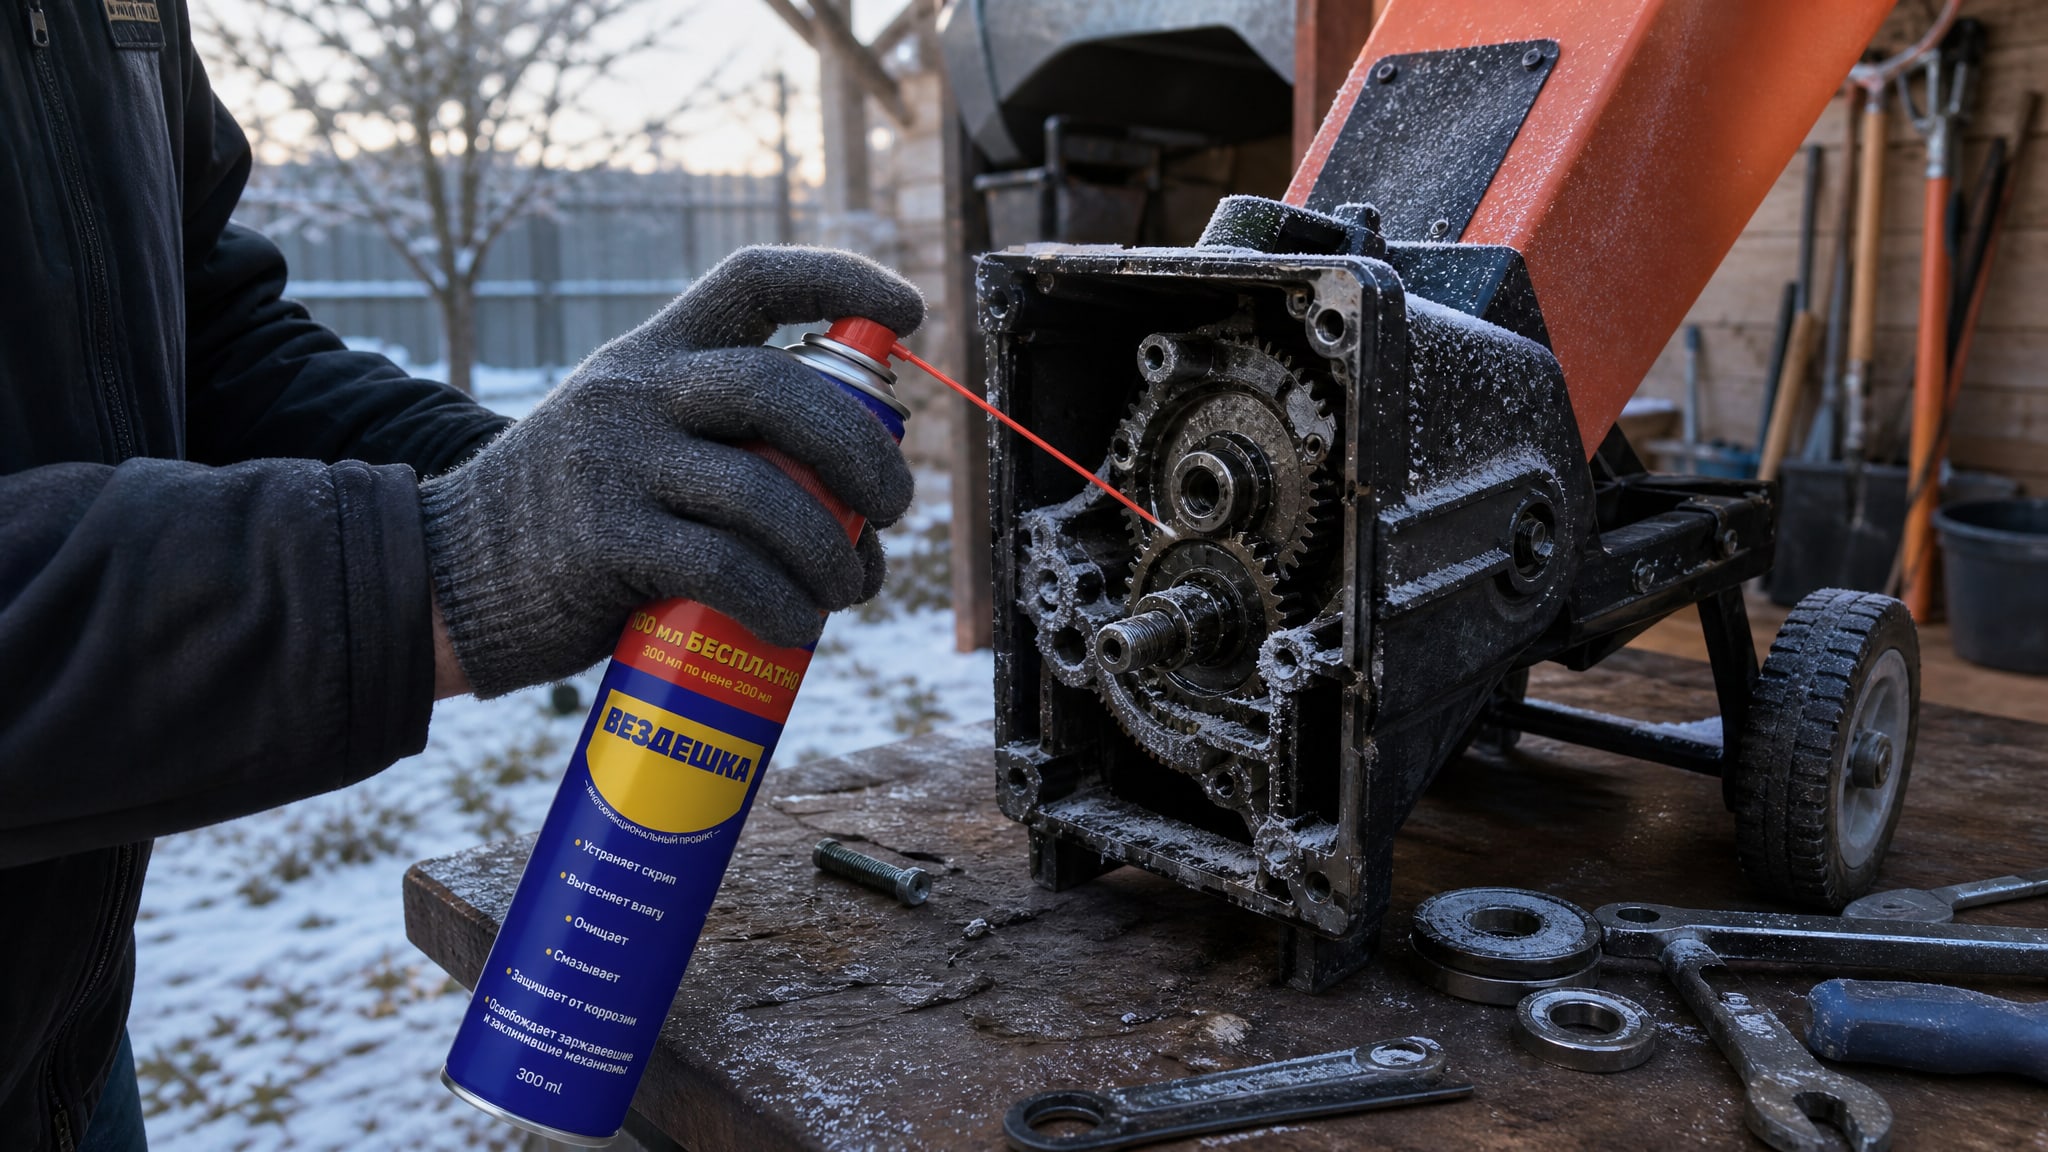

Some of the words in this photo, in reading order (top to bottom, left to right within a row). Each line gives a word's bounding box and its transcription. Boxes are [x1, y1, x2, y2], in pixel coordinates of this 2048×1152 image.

[632, 611, 657, 634] 100
[656, 624, 684, 646] мл
[685, 630, 800, 691] БЕСПЛАТНО
[642, 644, 665, 663] 300
[665, 655, 682, 670] мл
[683, 663, 701, 677] по
[701, 669, 733, 689] цене
[733, 680, 759, 698] 200
[758, 691, 773, 704] мл
[602, 706, 752, 783] ВЕЗДЕШКА
[583, 839, 641, 873] Устраняет
[642, 866, 677, 886] скрип
[566, 873, 631, 908] Вытесняет
[630, 901, 665, 922] влагу
[574, 916, 630, 946] Очищает
[553, 949, 621, 984] Смазывает
[511, 968, 569, 1003] Защищает
[568, 997, 584, 1010] от
[584, 1003, 638, 1027] коррозии
[483, 1012, 490, 1024] и
[564, 1051, 628, 1076] механизмы
[489, 998, 558, 1040] Освобождает
[557, 1033, 634, 1063] заржавевшие
[516, 1067, 545, 1088] 300
